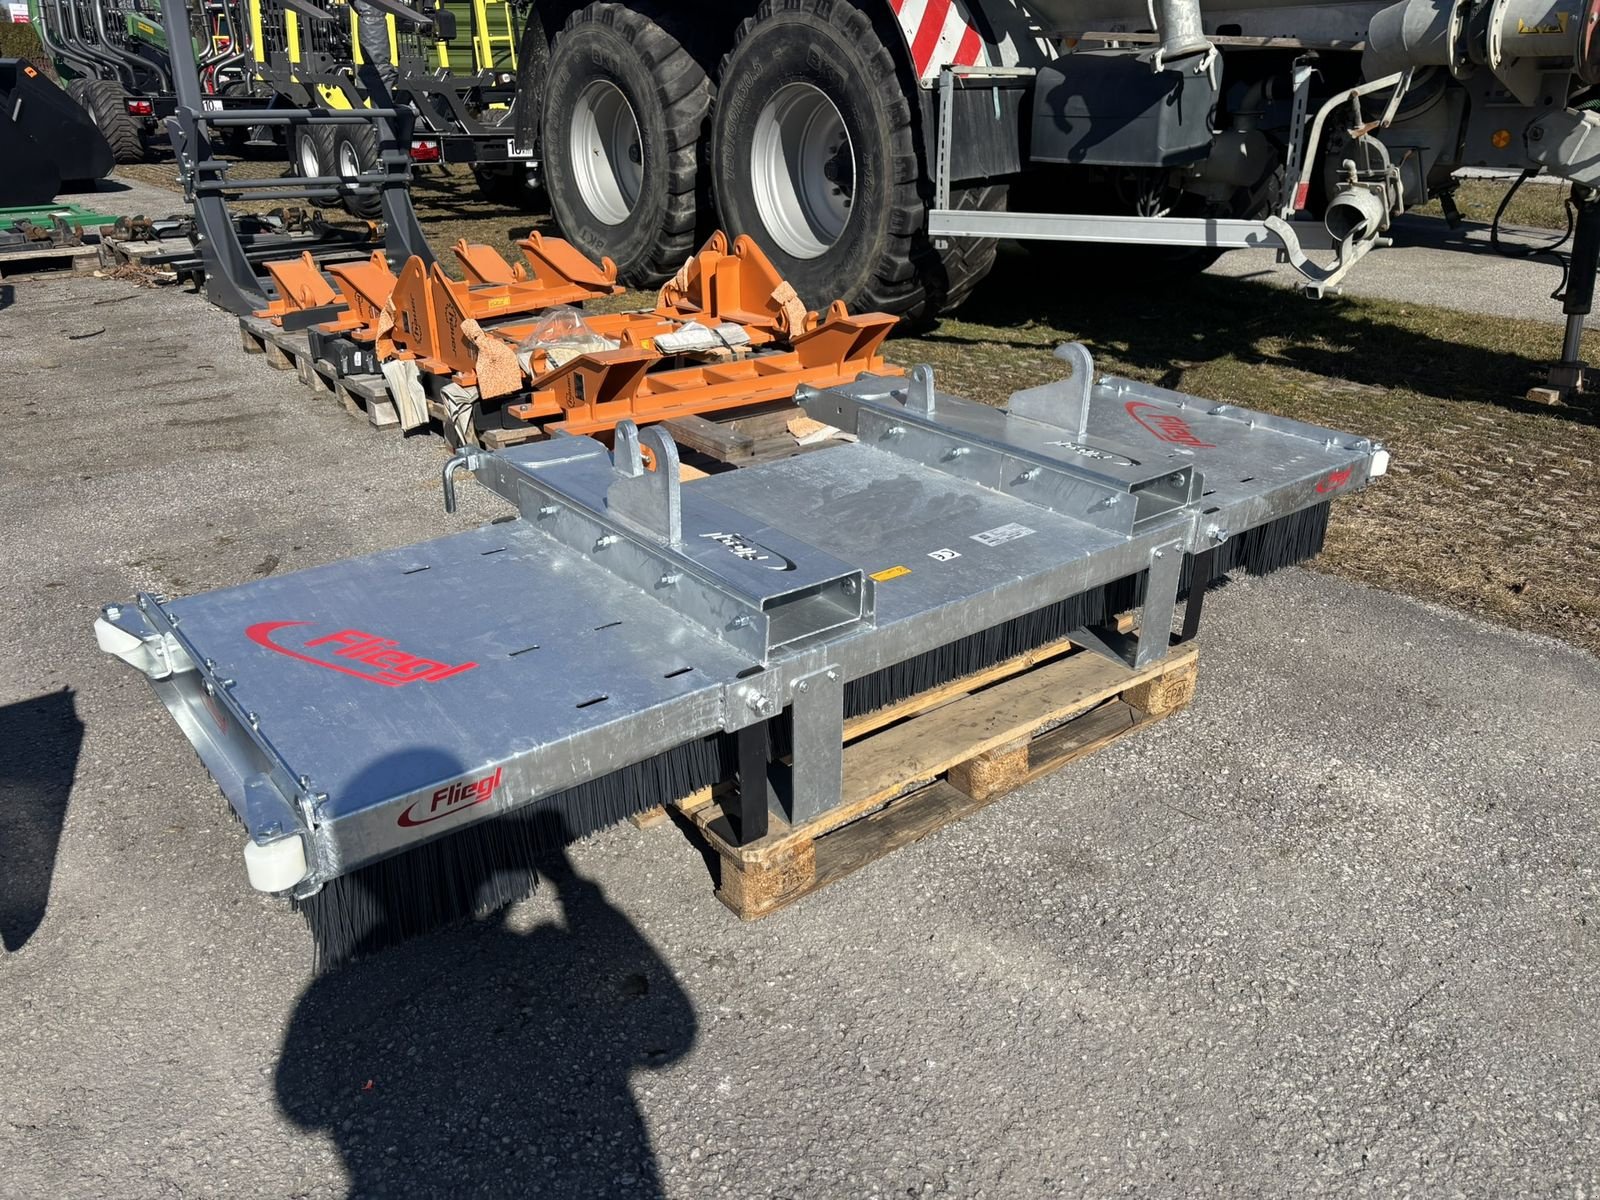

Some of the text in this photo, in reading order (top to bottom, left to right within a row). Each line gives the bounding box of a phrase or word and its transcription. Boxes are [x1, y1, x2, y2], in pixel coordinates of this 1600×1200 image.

[1144, 413, 1217, 448] Fliegl
[304, 627, 480, 688] Fliegl
[430, 766, 503, 814] Fliegl
